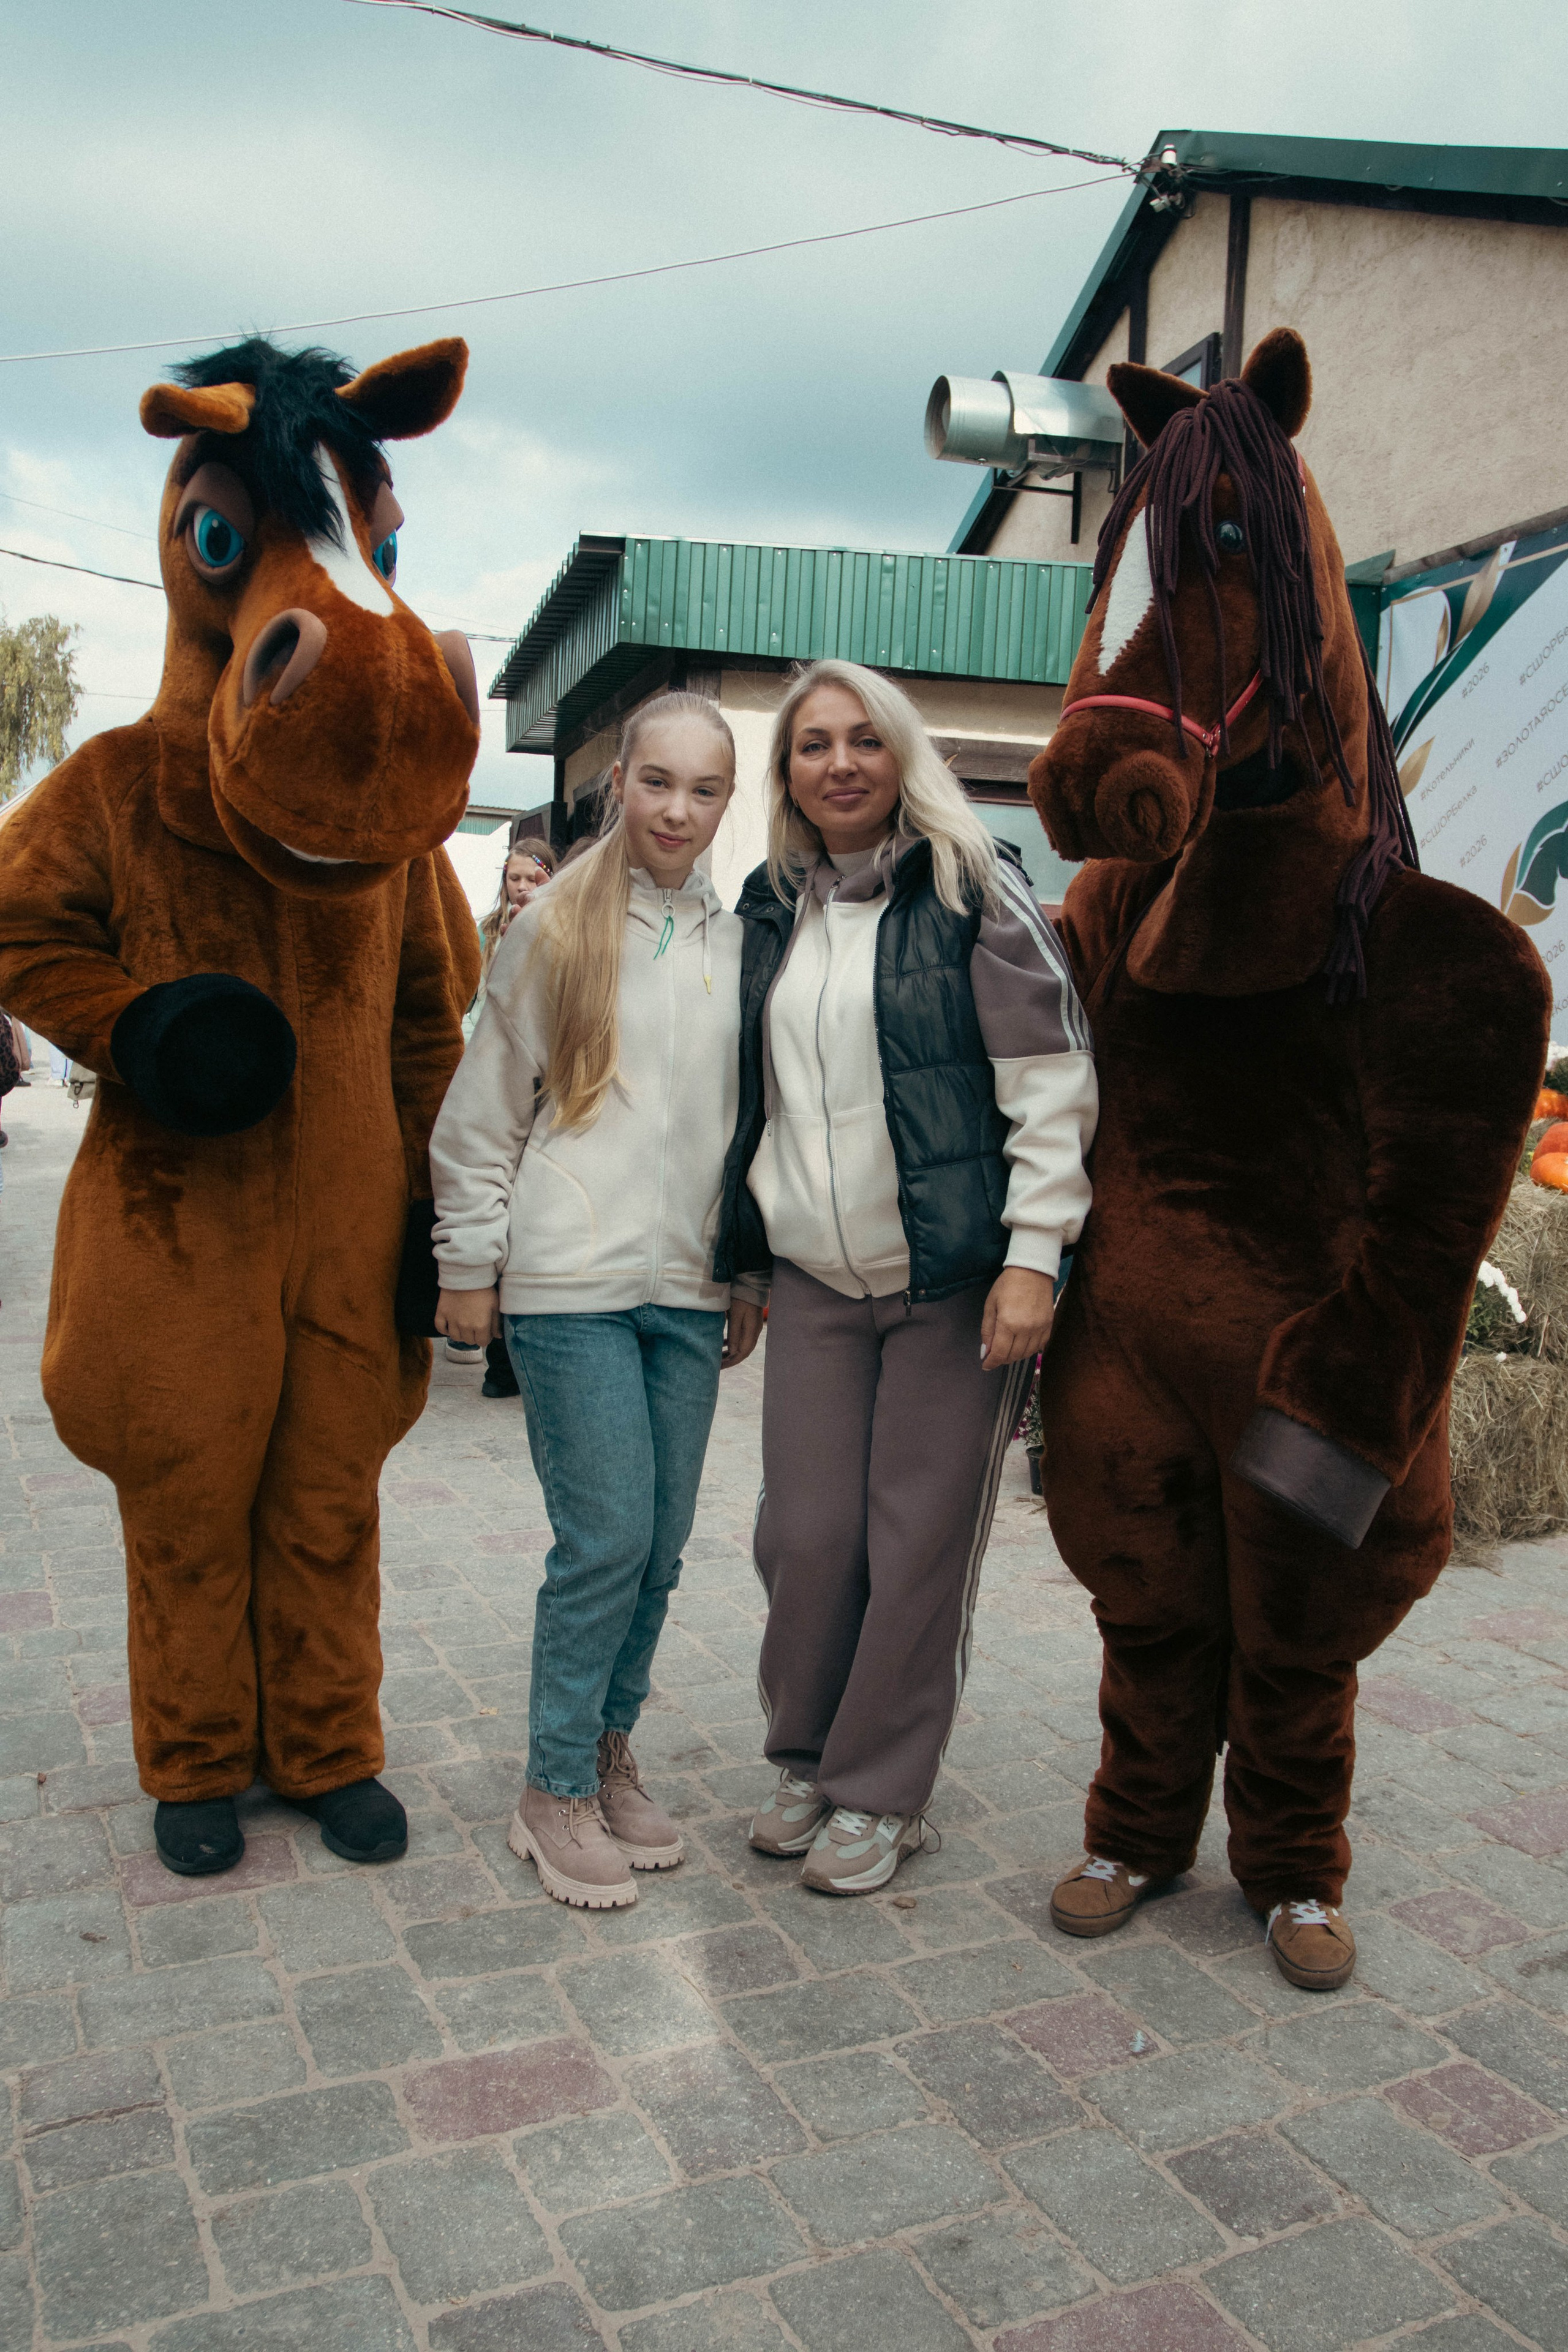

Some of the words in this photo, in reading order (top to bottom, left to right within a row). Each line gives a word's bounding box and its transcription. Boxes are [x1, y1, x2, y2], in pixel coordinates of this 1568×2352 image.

[1461, 662, 1490, 698] #2026
[1420, 737, 1475, 801] #Котельники
[1420, 785, 1478, 849] #СШОРБелка
[1460, 835, 1487, 867] #2026
